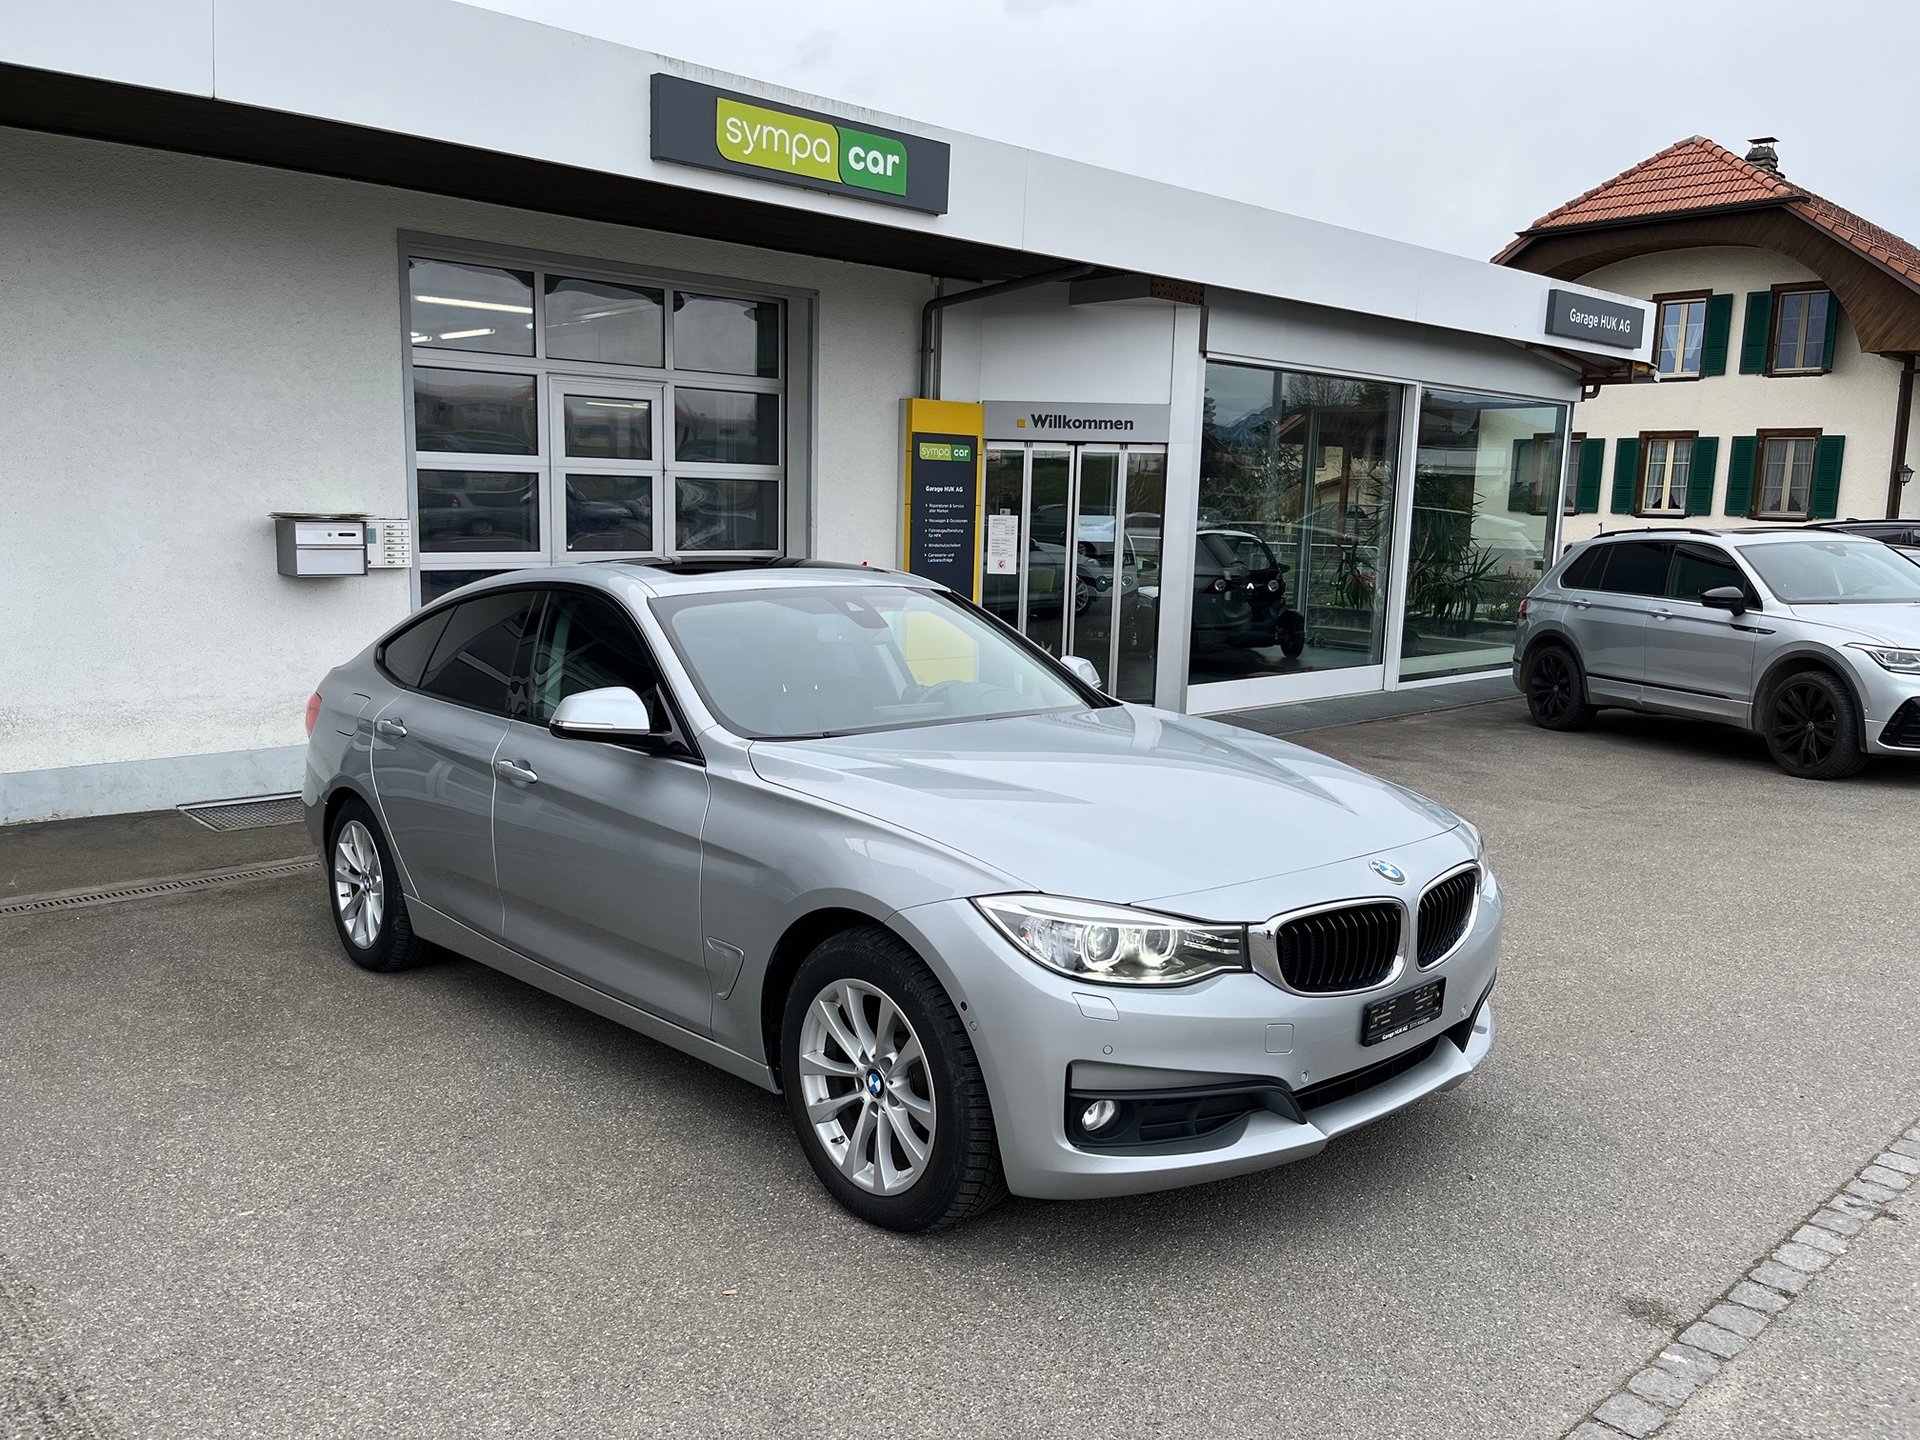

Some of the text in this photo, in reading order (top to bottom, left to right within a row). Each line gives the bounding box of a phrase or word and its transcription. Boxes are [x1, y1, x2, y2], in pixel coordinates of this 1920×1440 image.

[725, 117, 899, 176] sympa car
[1569, 308, 1631, 333] Garage HUK AG
[1030, 414, 1134, 430] Willkommen
[921, 447, 969, 458] sympa car
[925, 485, 943, 493] Garage
